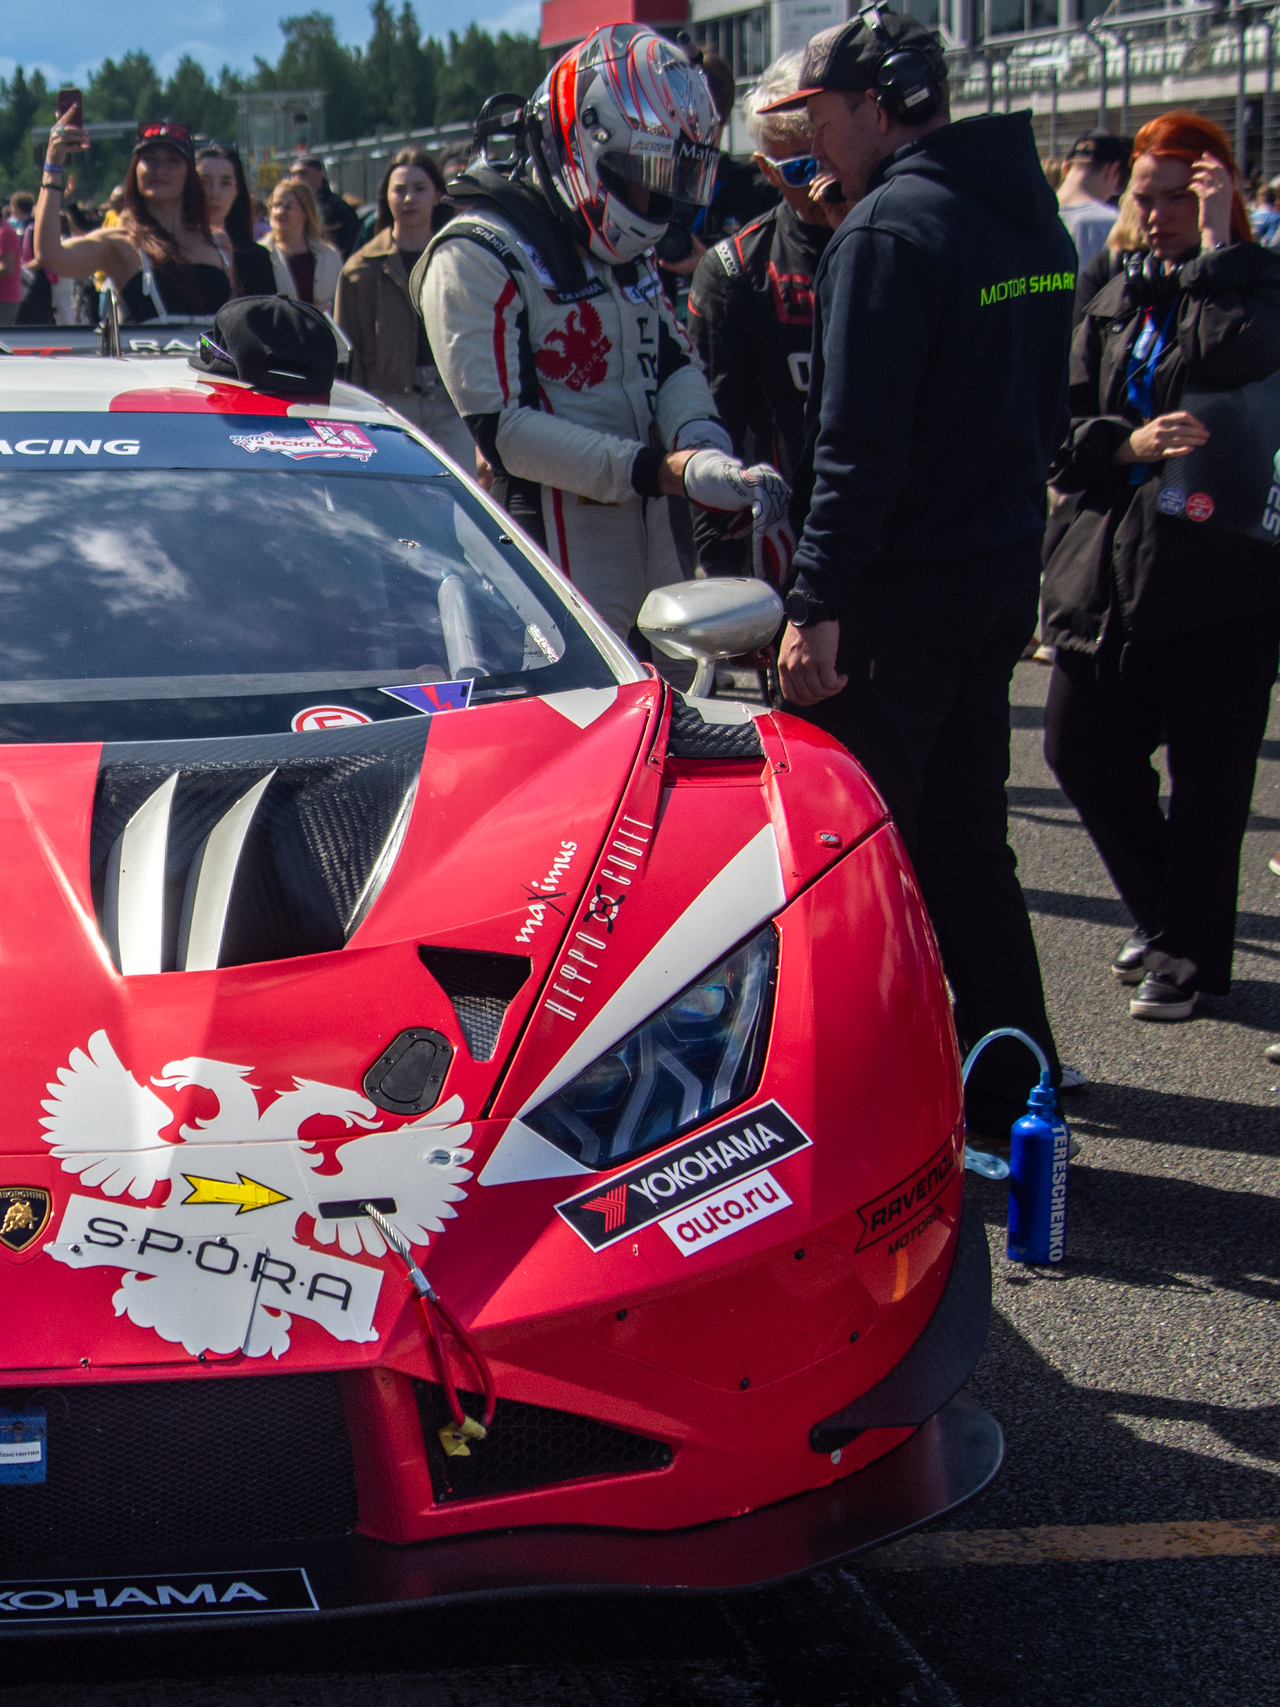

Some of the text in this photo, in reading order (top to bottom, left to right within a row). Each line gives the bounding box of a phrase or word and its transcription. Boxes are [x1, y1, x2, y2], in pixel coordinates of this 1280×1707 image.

[980, 271, 1075, 307] MOTOR SHARK
[571, 344, 607, 387] SPORA
[628, 1122, 785, 1205] YOKOHAMA
[1048, 1124, 1069, 1263] TERESCHENKO
[676, 1181, 781, 1243] auto.ru
